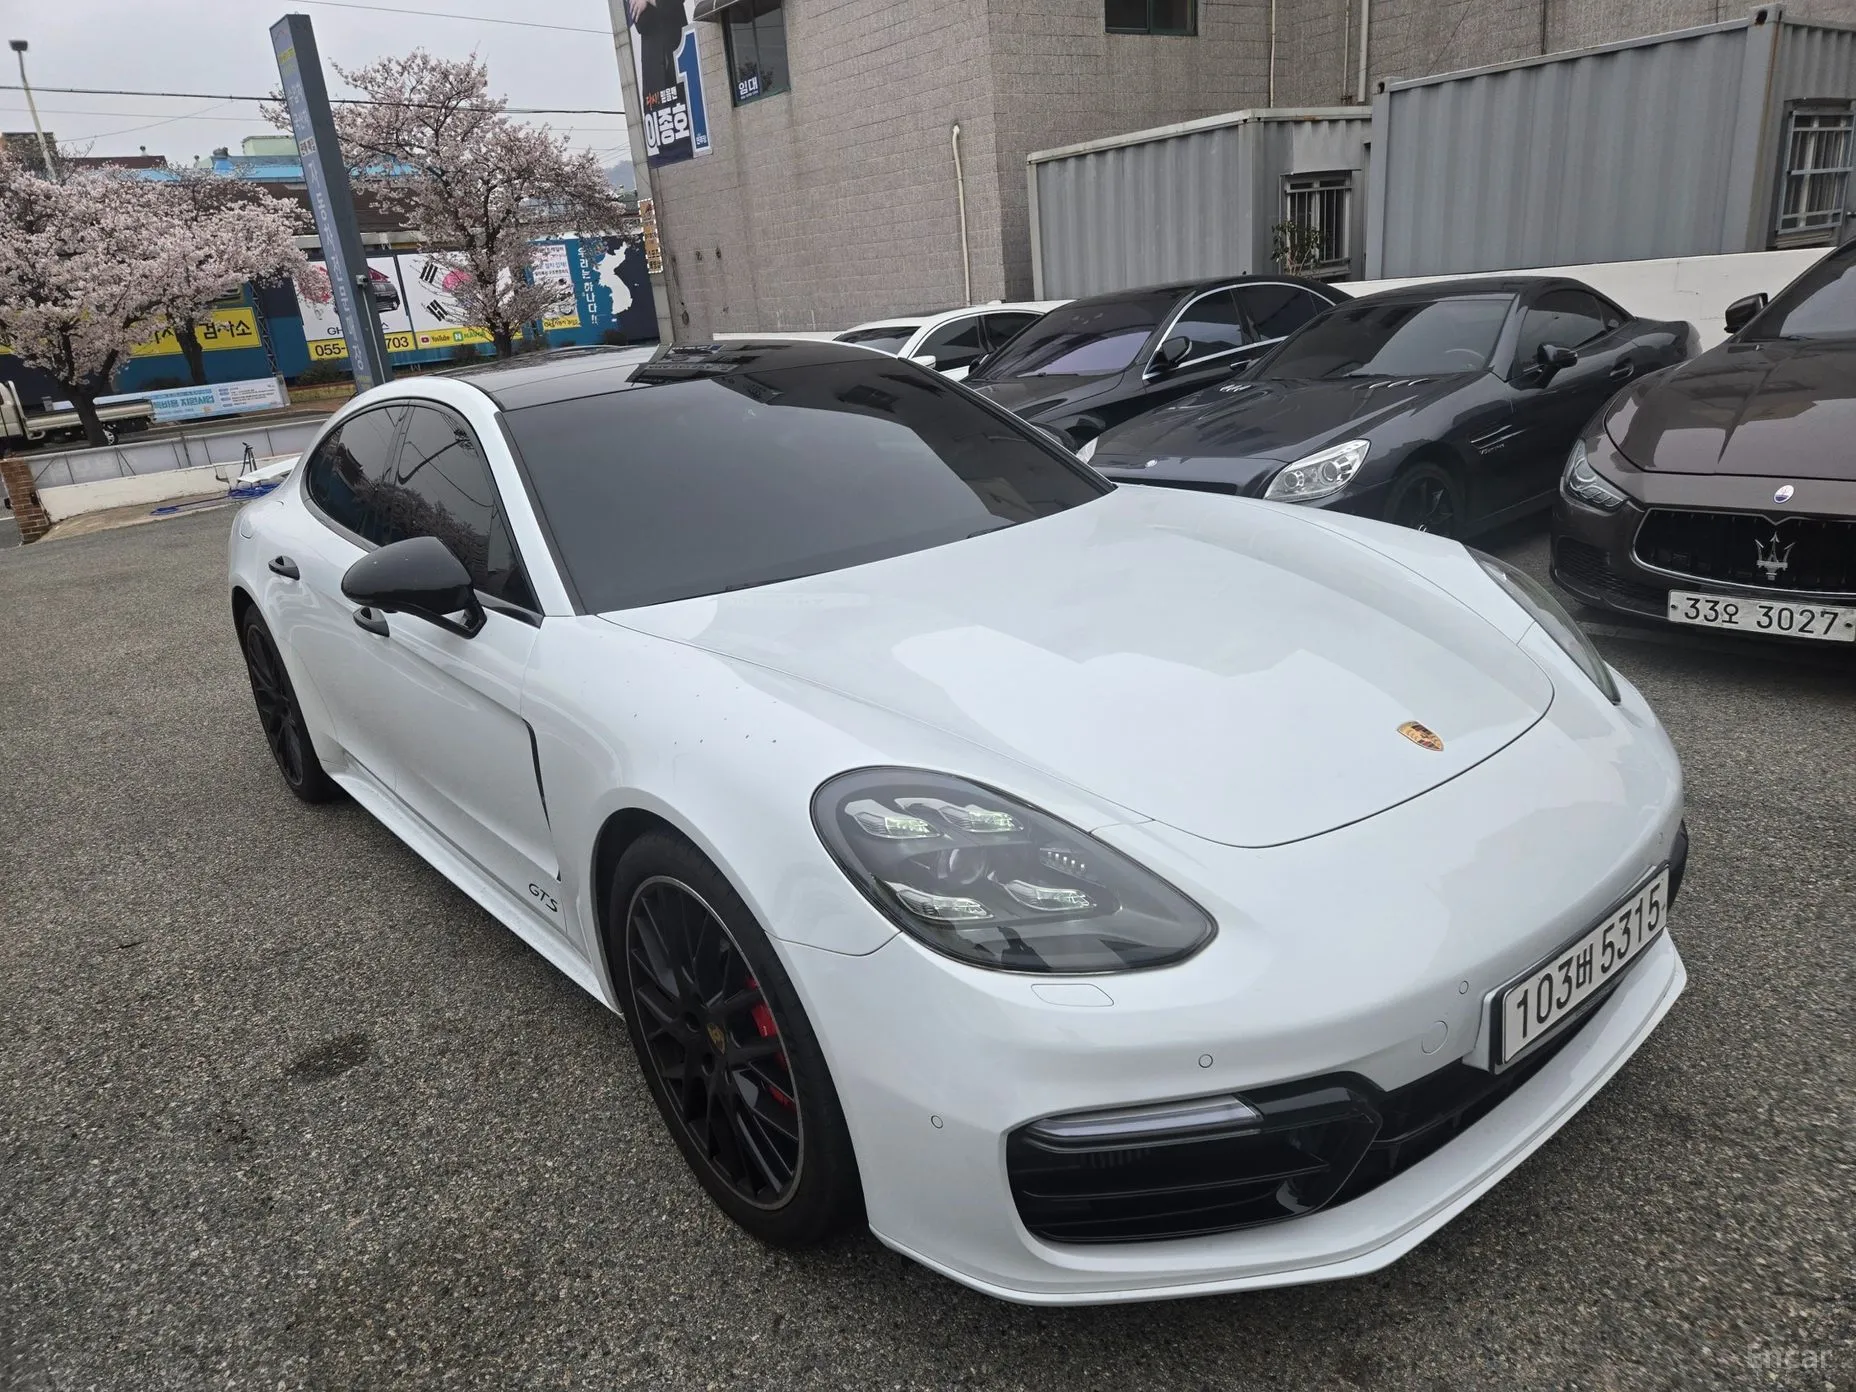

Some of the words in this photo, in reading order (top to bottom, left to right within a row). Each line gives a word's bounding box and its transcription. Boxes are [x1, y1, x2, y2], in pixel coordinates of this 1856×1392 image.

[677, 30, 710, 150] 1
[738, 76, 758, 96] 임대
[645, 102, 690, 147] 이종호
[578, 247, 591, 279] 우리는
[431, 335, 450, 343] YouTube
[1683, 596, 1739, 625] 33오
[1756, 605, 1840, 635] 3027
[528, 882, 558, 913] GTS
[1517, 942, 1594, 1038] 103버
[1600, 883, 1661, 974] 5315
